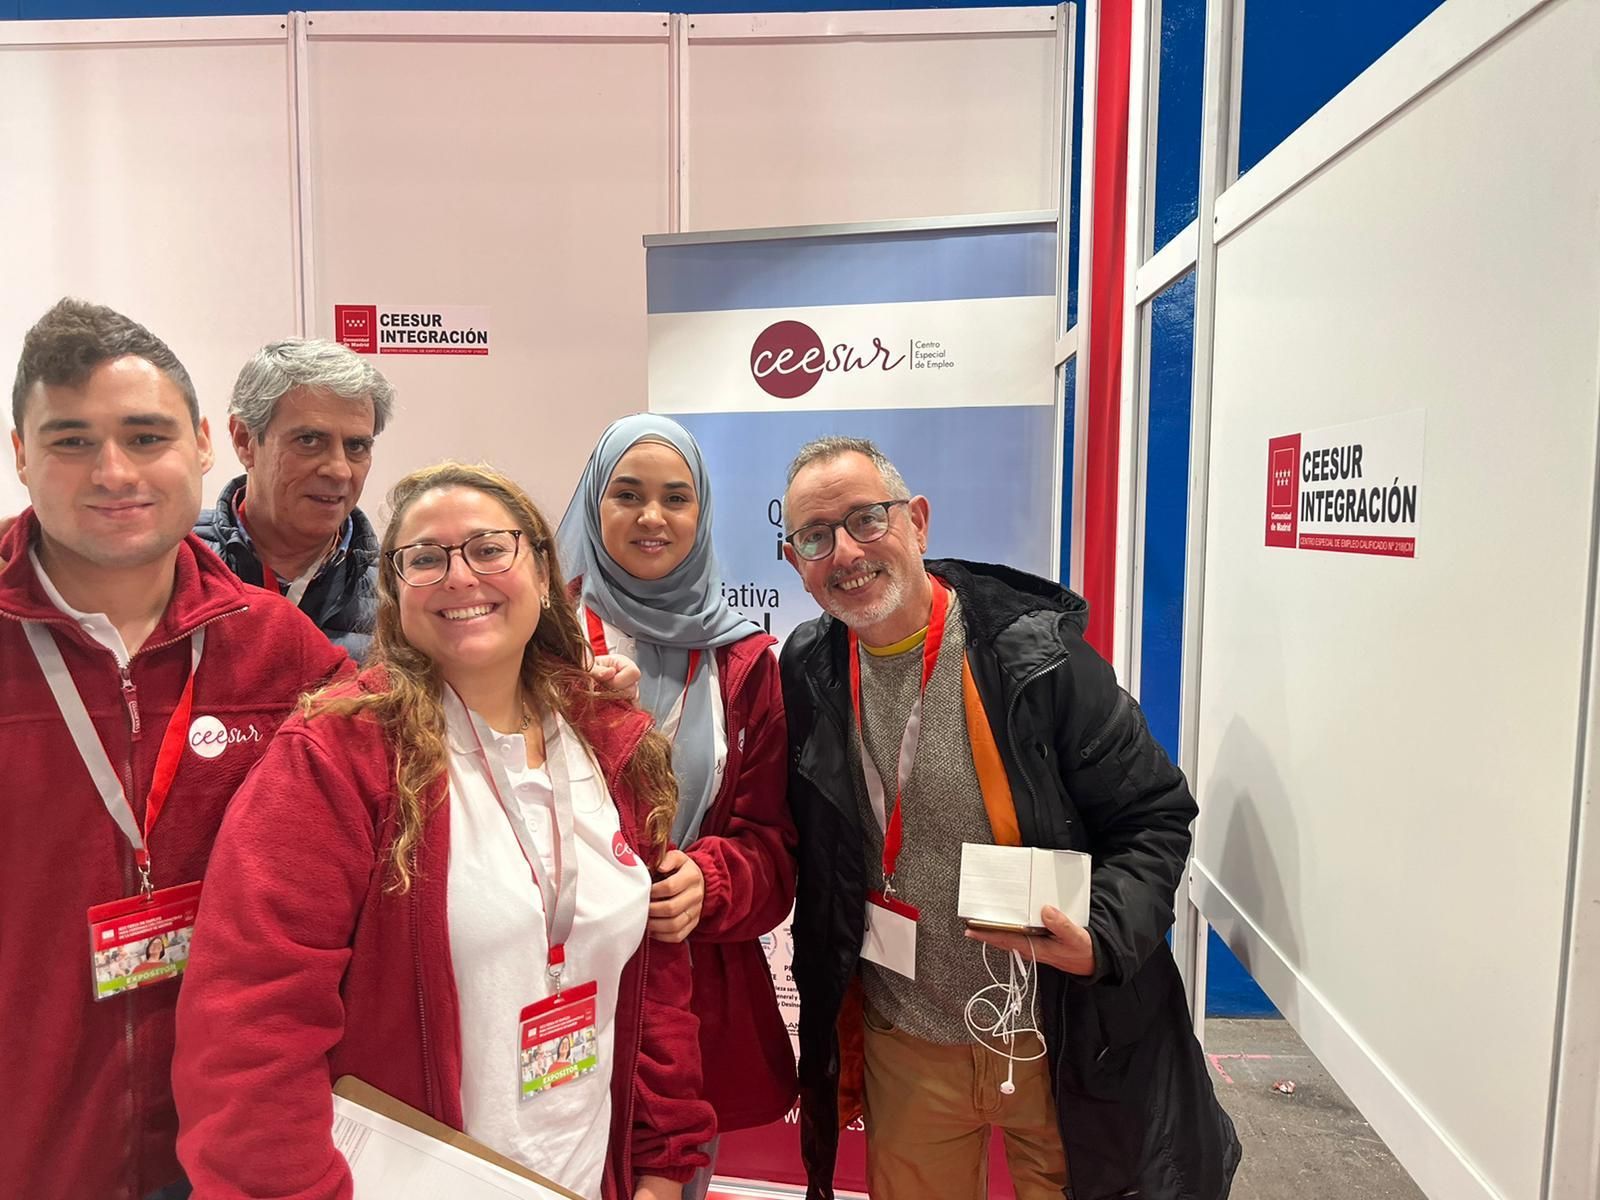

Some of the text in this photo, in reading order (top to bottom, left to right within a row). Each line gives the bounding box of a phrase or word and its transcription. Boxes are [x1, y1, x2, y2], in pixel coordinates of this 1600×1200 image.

[380, 314, 442, 327] CEESUR
[380, 328, 488, 344] INTEGRACIÓN
[915, 340, 941, 349] Centro
[753, 337, 906, 378] ceesur
[915, 350, 946, 360] Especial
[915, 360, 955, 370] de Empleo
[1302, 444, 1363, 482] CEESUR
[1300, 477, 1417, 523] INTEGRACIÓN
[191, 724, 263, 747] ceesur
